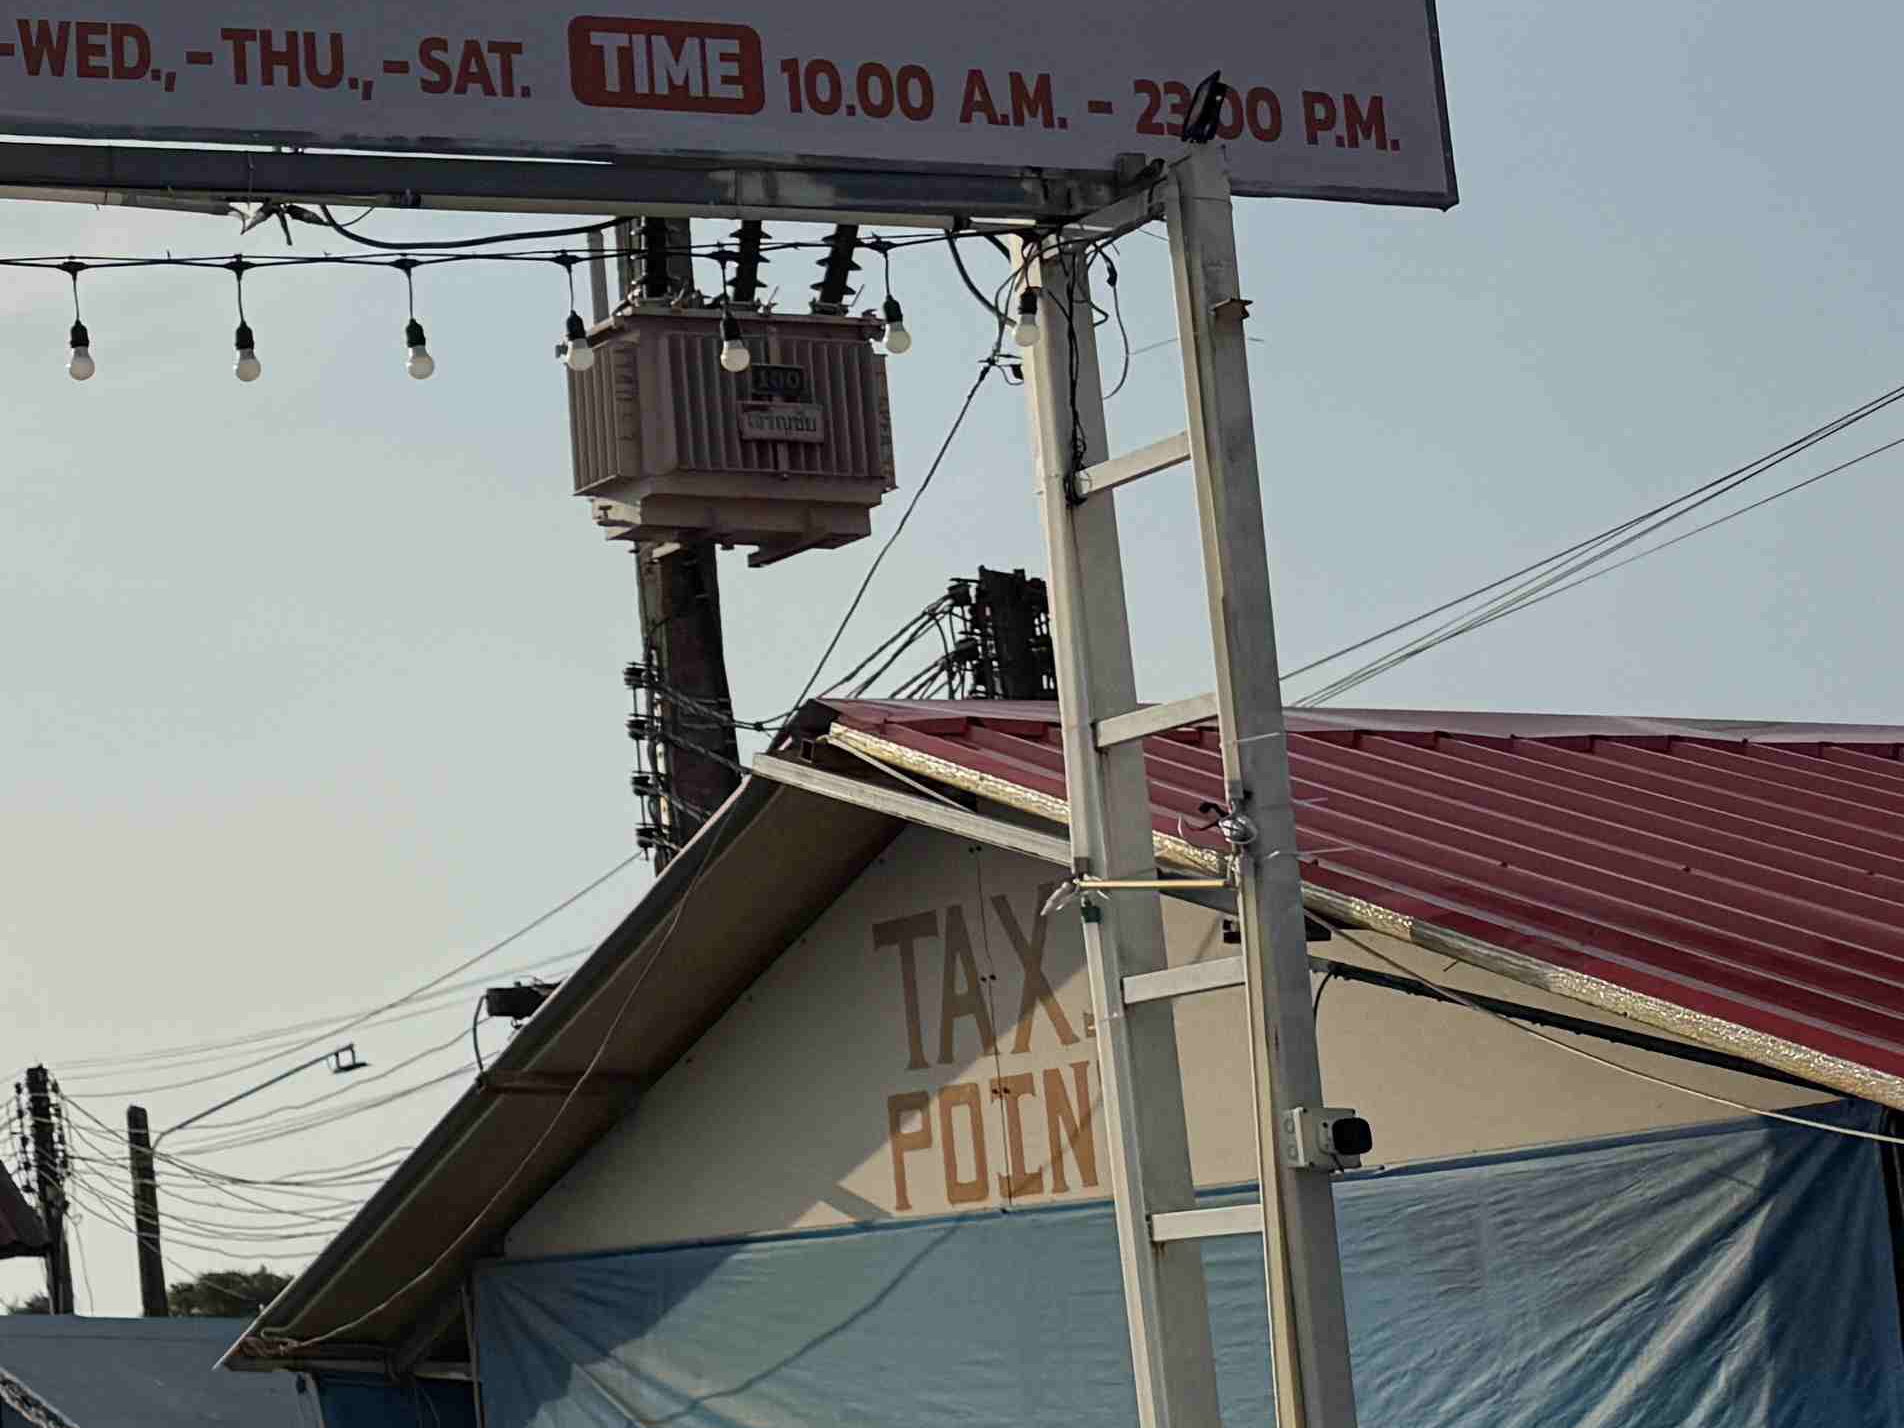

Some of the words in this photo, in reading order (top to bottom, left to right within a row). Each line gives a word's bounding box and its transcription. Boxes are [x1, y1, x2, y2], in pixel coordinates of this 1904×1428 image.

[589, 29, 747, 101] TIME
[781, 58, 935, 121] 10.00
[960, 69, 1069, 130] A.M.
[1133, 79, 1283, 143] 2300
[1302, 90, 1401, 151] P.M.
[872, 882, 1098, 1071] TAX
[887, 1060, 1100, 1213] POIN
